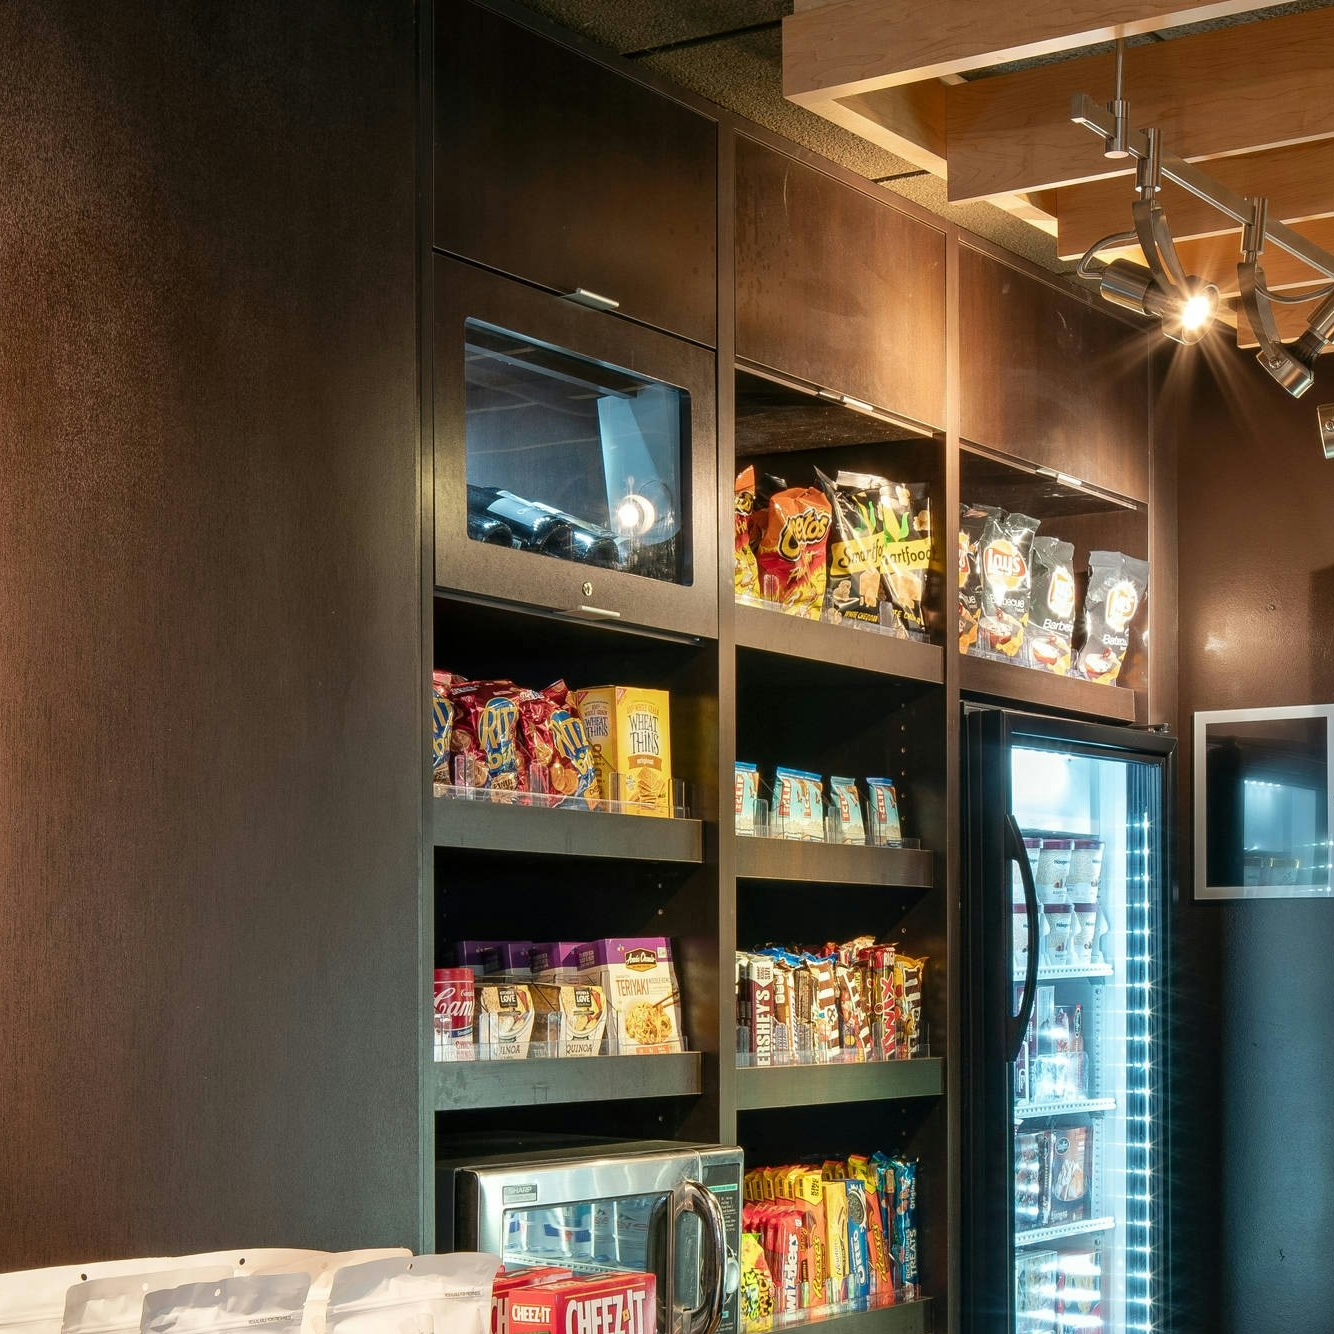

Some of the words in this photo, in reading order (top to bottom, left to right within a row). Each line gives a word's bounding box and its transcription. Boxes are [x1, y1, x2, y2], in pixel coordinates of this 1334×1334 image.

[628, 713, 658, 732] WHEAT
[616, 978, 649, 996] TERIYAKI
[566, 1043, 593, 1054] QUINOA
[853, 1230, 866, 1285] OREO
[909, 1228, 917, 1277] TREATS
